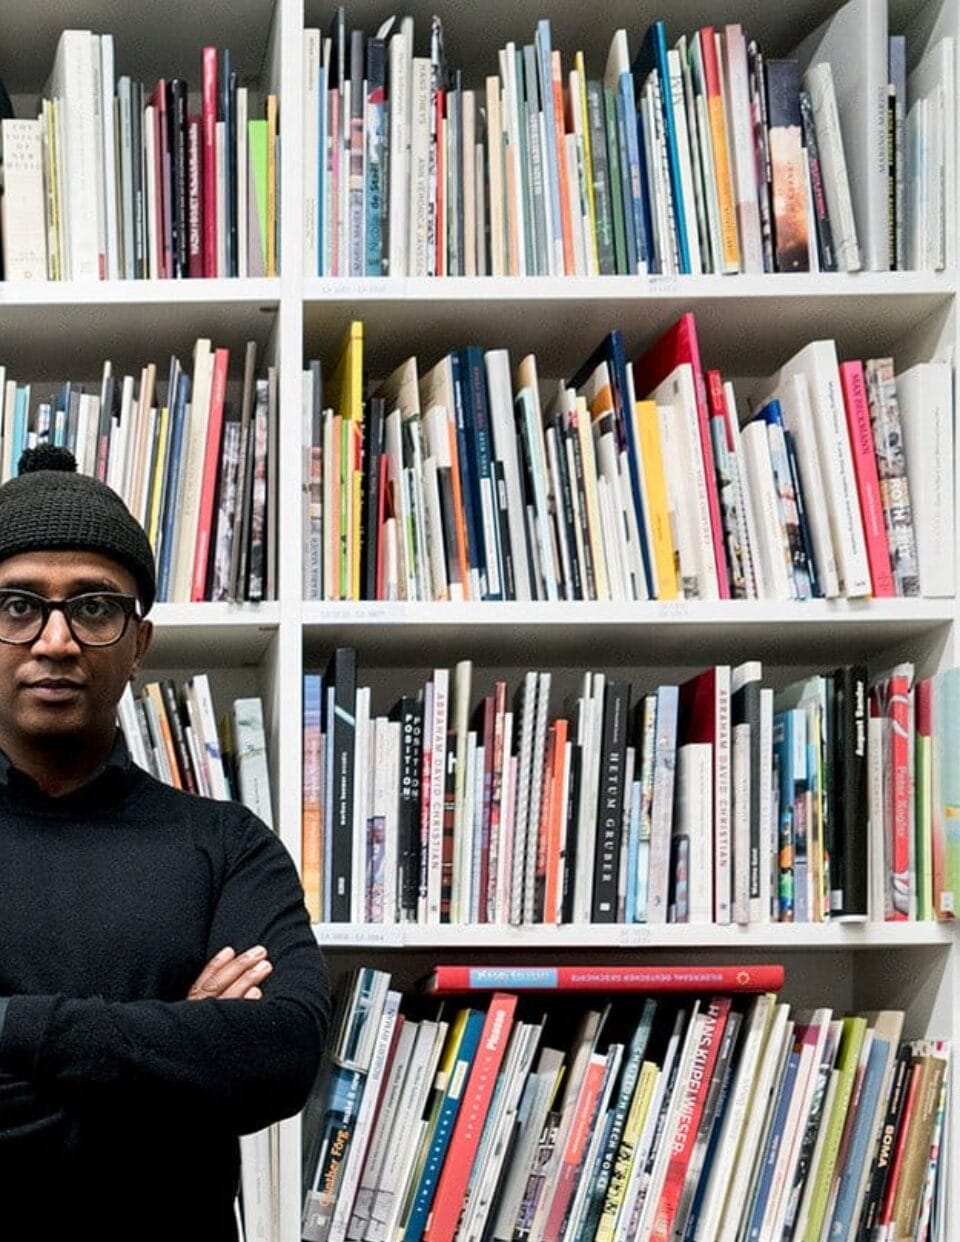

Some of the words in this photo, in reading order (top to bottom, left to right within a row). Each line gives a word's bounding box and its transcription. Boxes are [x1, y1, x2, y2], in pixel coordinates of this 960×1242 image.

[875, 130, 886, 173] MARINO
[852, 374, 864, 396] MAX
[855, 399, 869, 454] BECKMANN
[718, 689, 727, 748] ABRAHAM
[854, 680, 864, 717] Sander
[433, 693, 446, 752] ABRAHAM
[855, 720, 865, 756] August
[403, 714, 413, 799] POSITION
[718, 755, 727, 792] DAVID
[432, 760, 443, 796] DAVID
[896, 765, 906, 795] Peter
[429, 802, 442, 869] CHRISTIAN
[719, 799, 728, 866] CHRISTIAN
[894, 799, 906, 837] Kogler
[600, 817, 614, 882] GRUBER
[623, 972, 671, 981] DEUTSCHER
[487, 1010, 505, 1050] Picasso
[701, 1004, 720, 1048] HANS
[672, 1049, 707, 1154] KUPELWIESER
[333, 1128, 351, 1158] Förg
